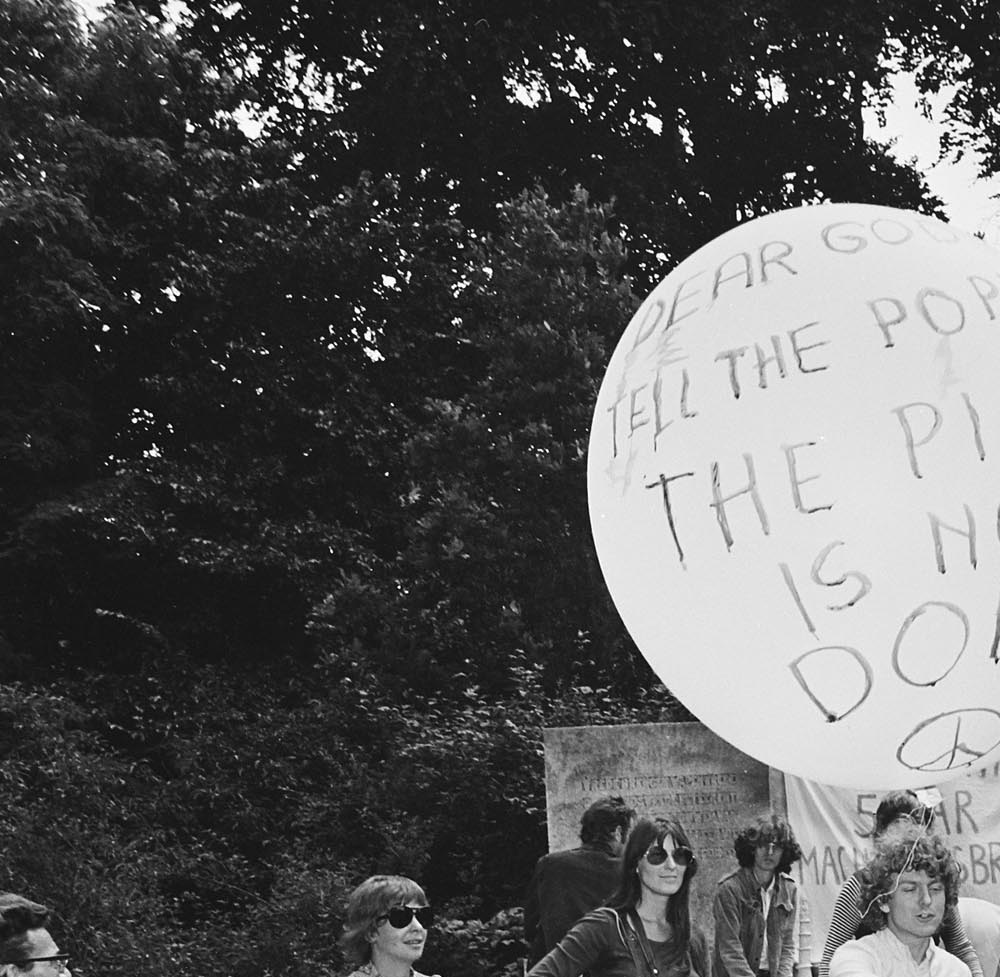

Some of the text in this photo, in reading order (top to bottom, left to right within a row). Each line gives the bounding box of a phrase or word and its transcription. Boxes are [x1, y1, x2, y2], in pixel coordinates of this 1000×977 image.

[634, 240, 799, 352] DEAR
[607, 367, 698, 459] TELL
[713, 321, 831, 400] THE
[643, 440, 834, 570] THE
[777, 540, 873, 641] IS
